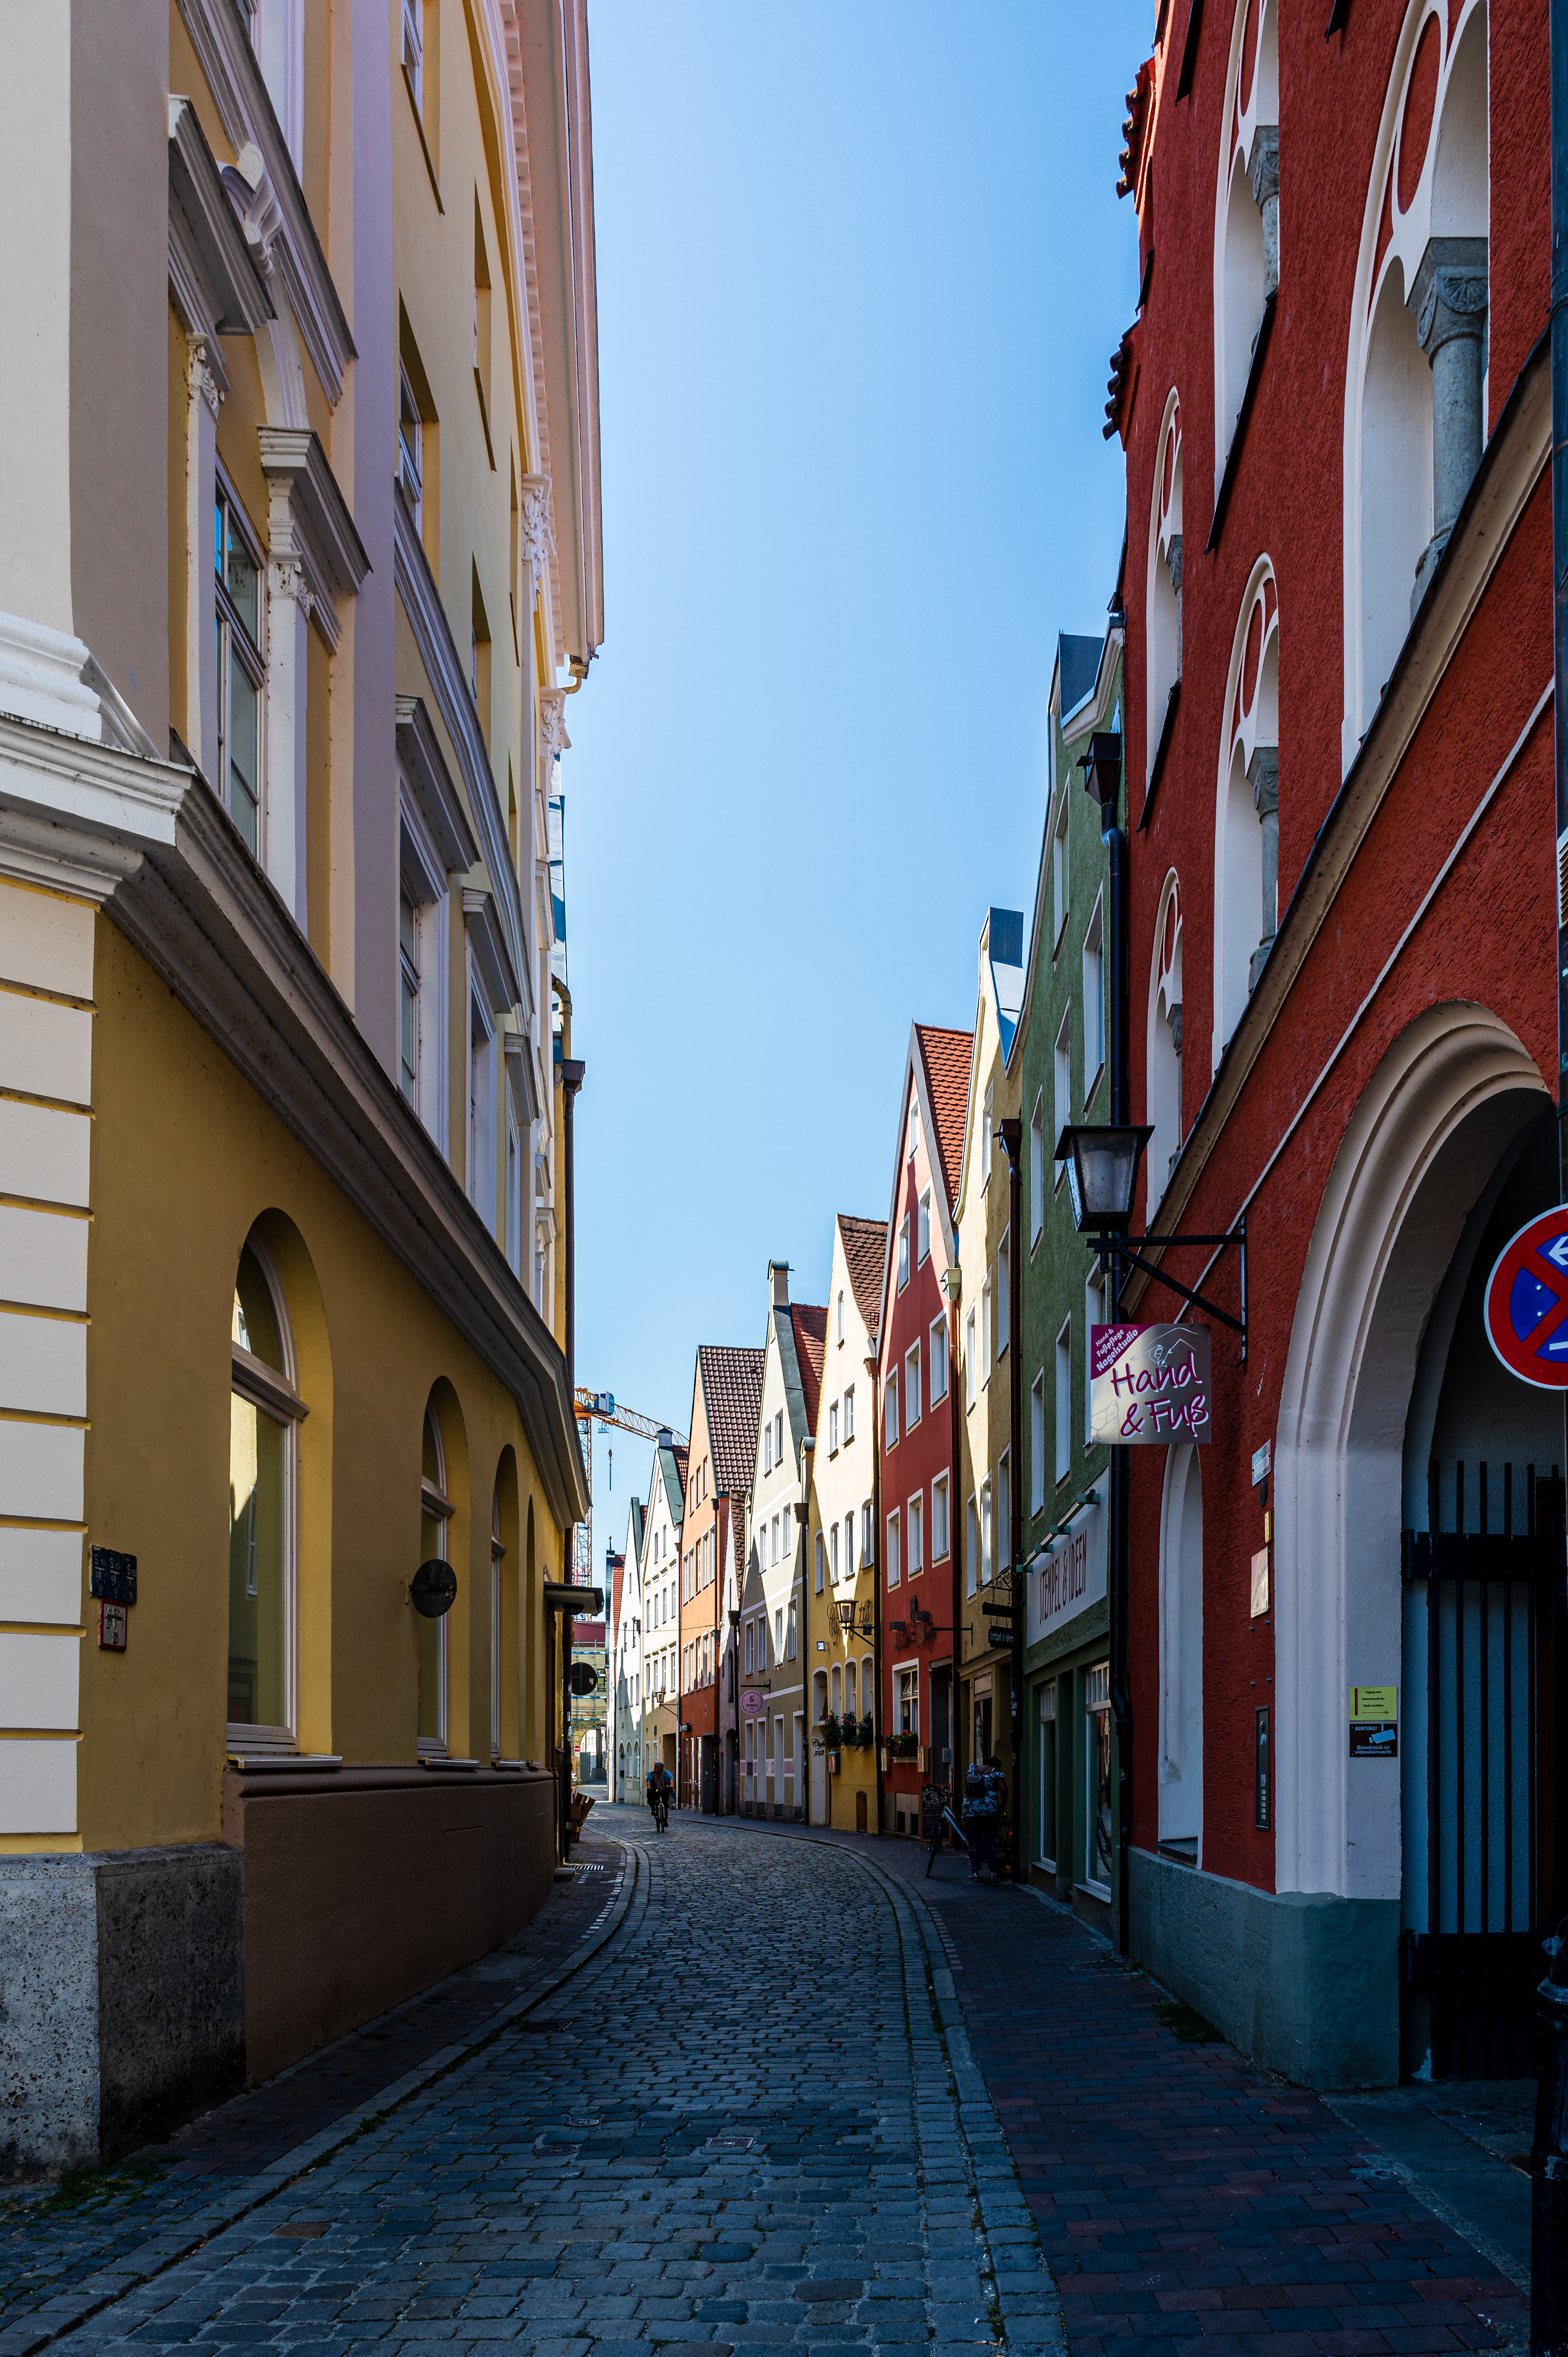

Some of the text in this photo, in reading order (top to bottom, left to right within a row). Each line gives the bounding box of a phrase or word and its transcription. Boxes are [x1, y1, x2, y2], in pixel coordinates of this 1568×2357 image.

[1096, 1329, 1125, 1358] Fußpflege
[1096, 1329, 1139, 1372] Nagelstudio
[1110, 1351, 1203, 1399] Hand
[1120, 1393, 1209, 1439] & Fuß
[94, 1554, 98, 1565] S
[110, 1558, 114, 1569] S
[1039, 1529, 1087, 1626] STEMPEL & IDEEN
[989, 1631, 1002, 1642] Stempel
[1005, 1633, 1014, 1642] Ideen
